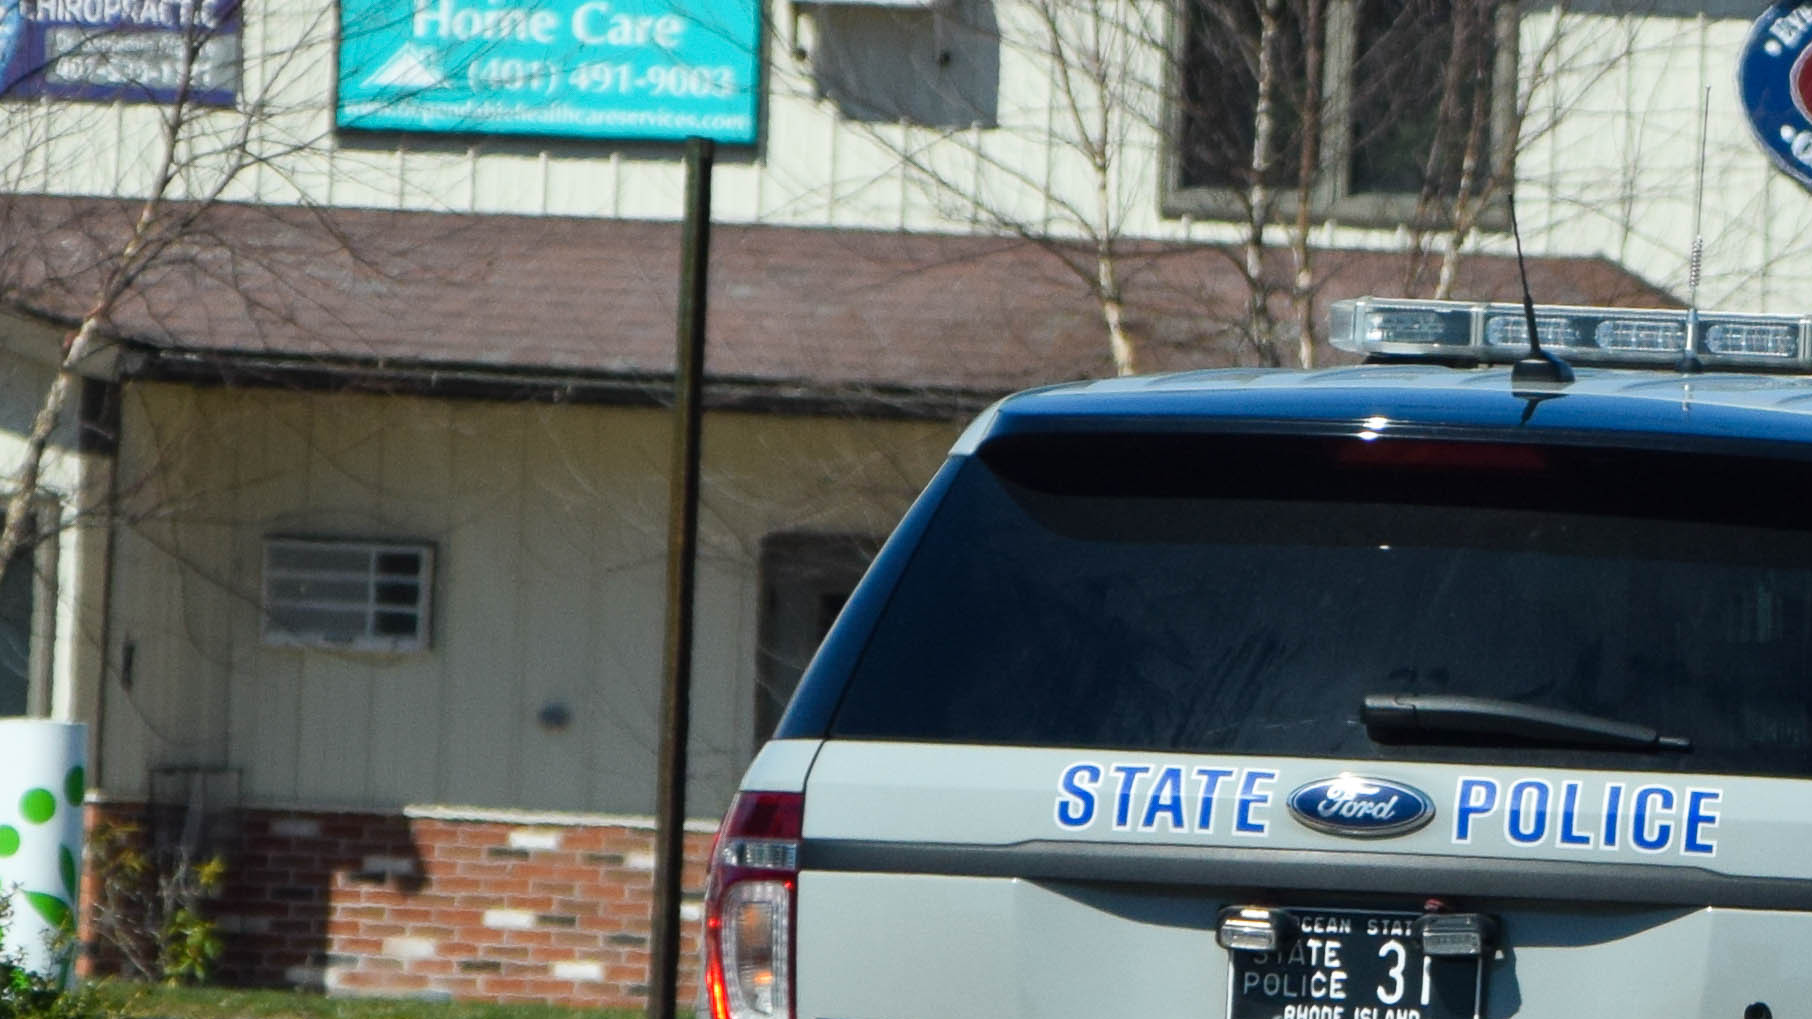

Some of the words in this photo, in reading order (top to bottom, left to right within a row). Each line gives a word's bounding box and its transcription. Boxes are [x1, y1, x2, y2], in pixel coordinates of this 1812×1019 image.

[413, 0, 558, 43] Home
[572, 1, 686, 47] Care
[467, 59, 555, 94] (401)
[568, 62, 737, 98] 491-9003
[1055, 761, 1279, 837] STATE
[1317, 781, 1398, 821] Ford
[1451, 774, 1723, 857] POLICE
[1296, 916, 1352, 934] CEAN
[1367, 918, 1413, 936] STAT
[1243, 971, 1348, 1000] POLICE
